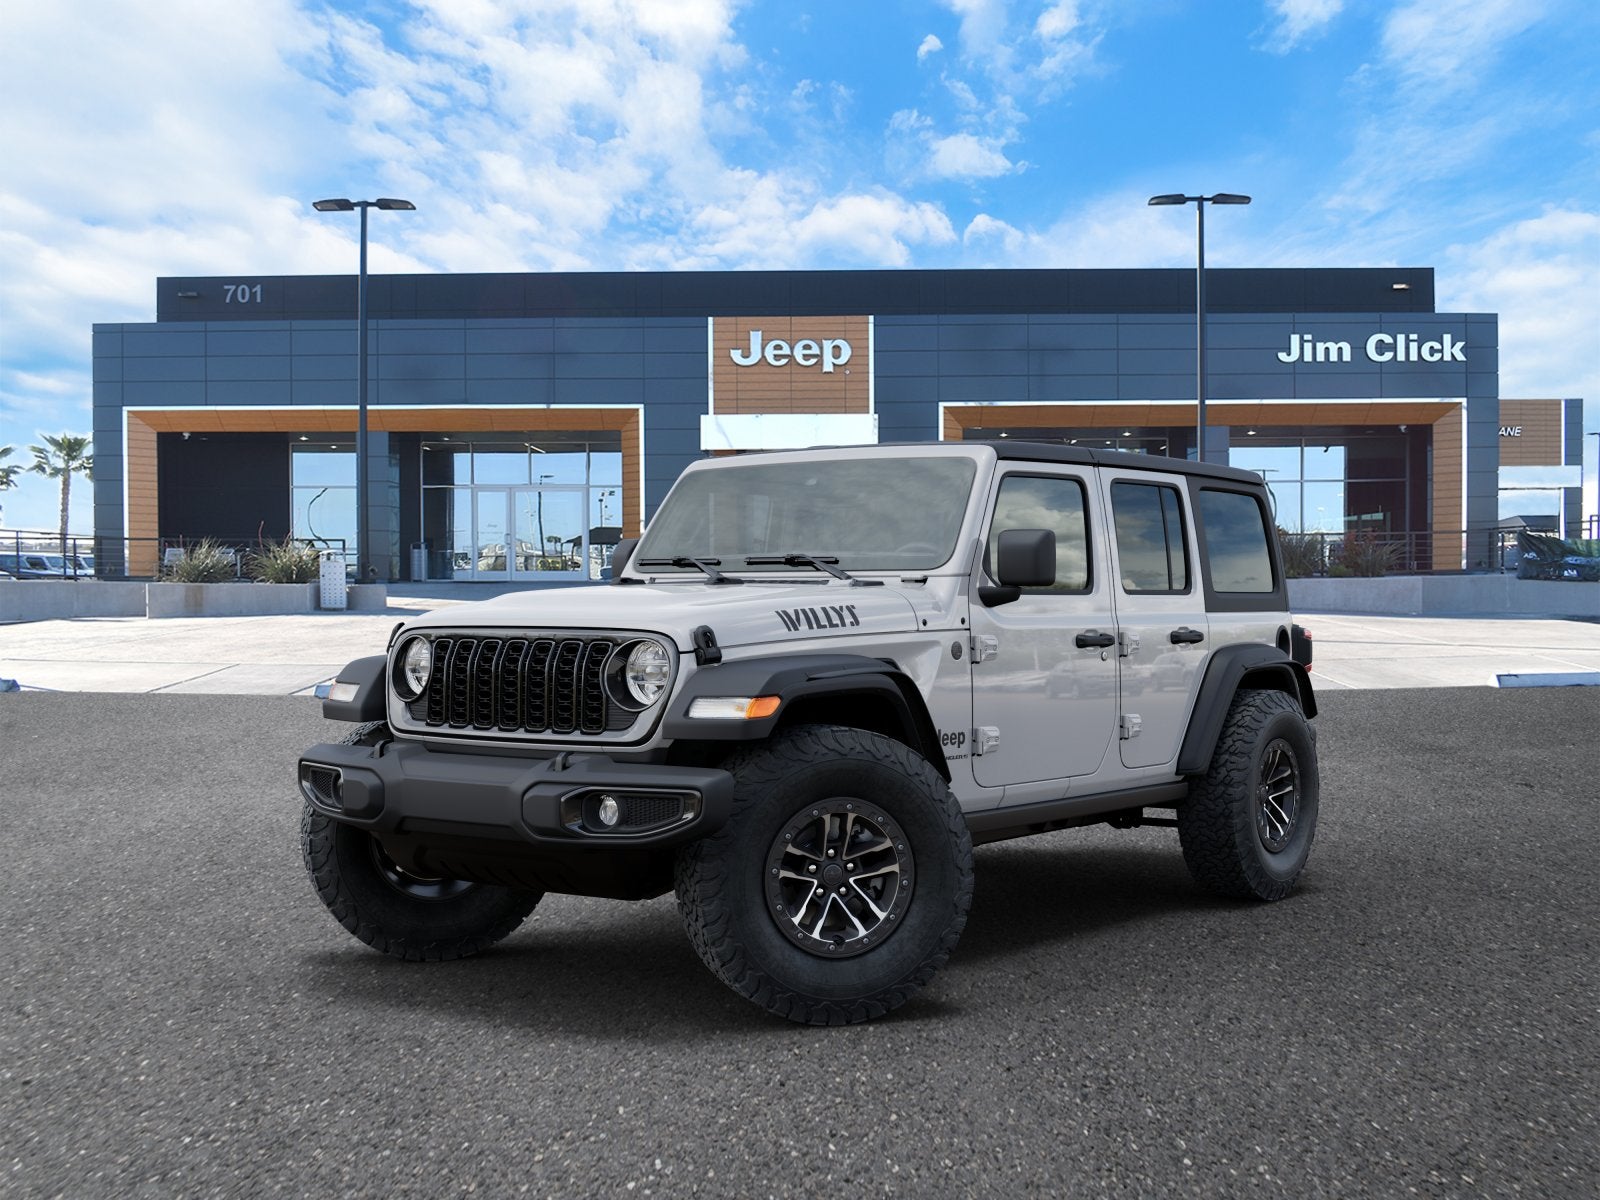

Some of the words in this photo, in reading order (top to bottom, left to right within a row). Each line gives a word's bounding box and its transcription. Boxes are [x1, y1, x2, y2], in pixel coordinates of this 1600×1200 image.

[223, 284, 262, 303] 701
[729, 330, 852, 373] Jeep
[1277, 333, 1351, 362] Jim
[1366, 333, 1467, 362] Click
[1498, 426, 1522, 437] ANE
[774, 604, 860, 632] WILLYS
